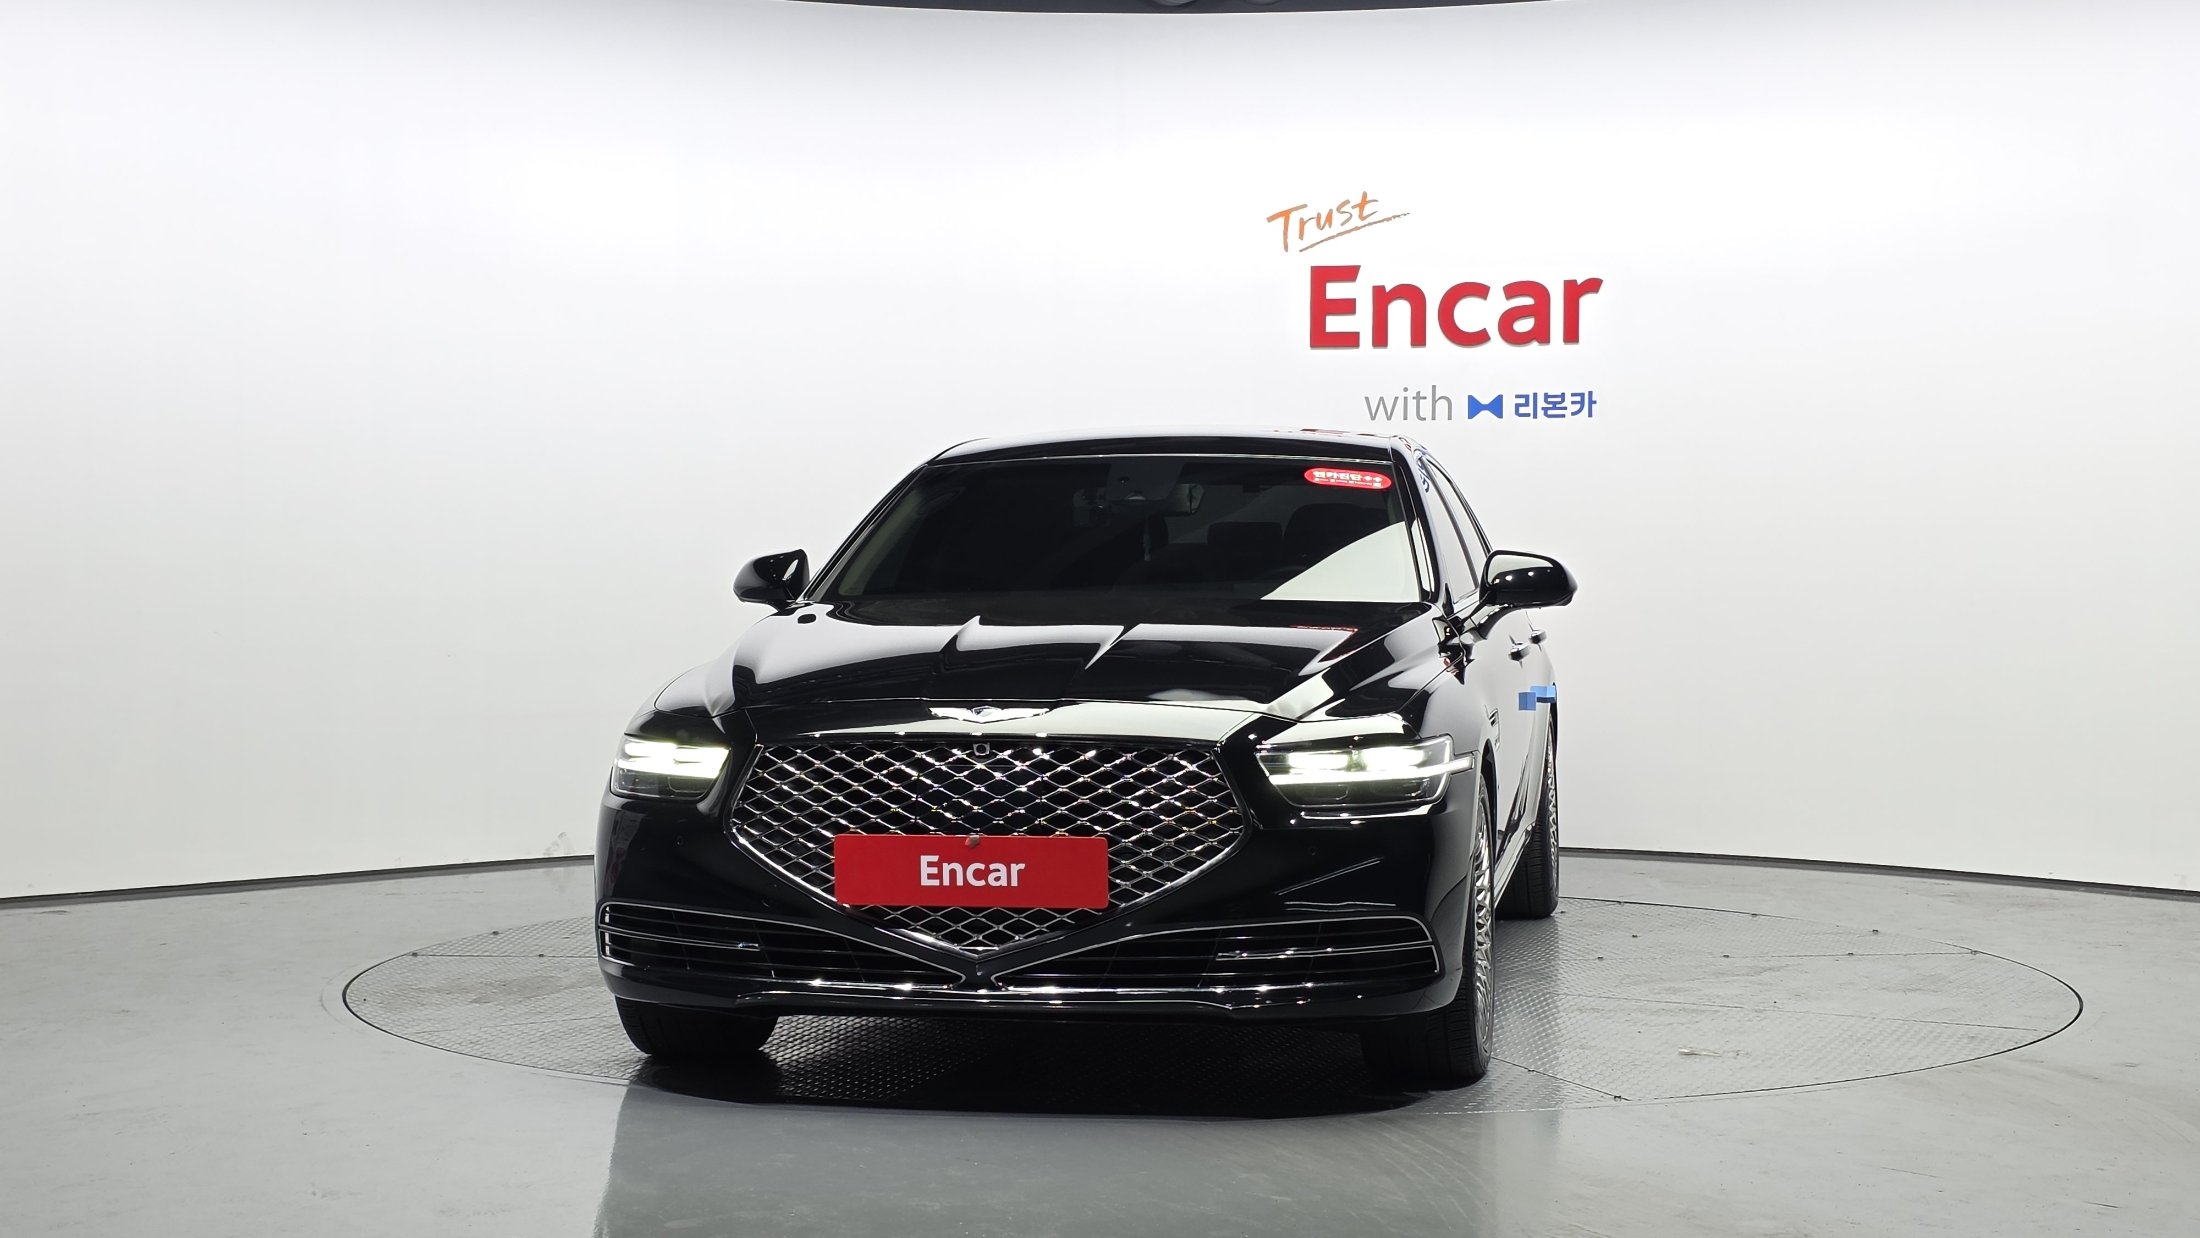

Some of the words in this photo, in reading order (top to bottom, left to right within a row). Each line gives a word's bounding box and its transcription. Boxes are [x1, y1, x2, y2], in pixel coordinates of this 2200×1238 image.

[1266, 191, 1380, 252] Trust
[1310, 265, 1603, 349] Encar
[1364, 385, 1453, 421] with
[1514, 391, 1597, 419] 리본카
[920, 855, 1026, 887] Encar
